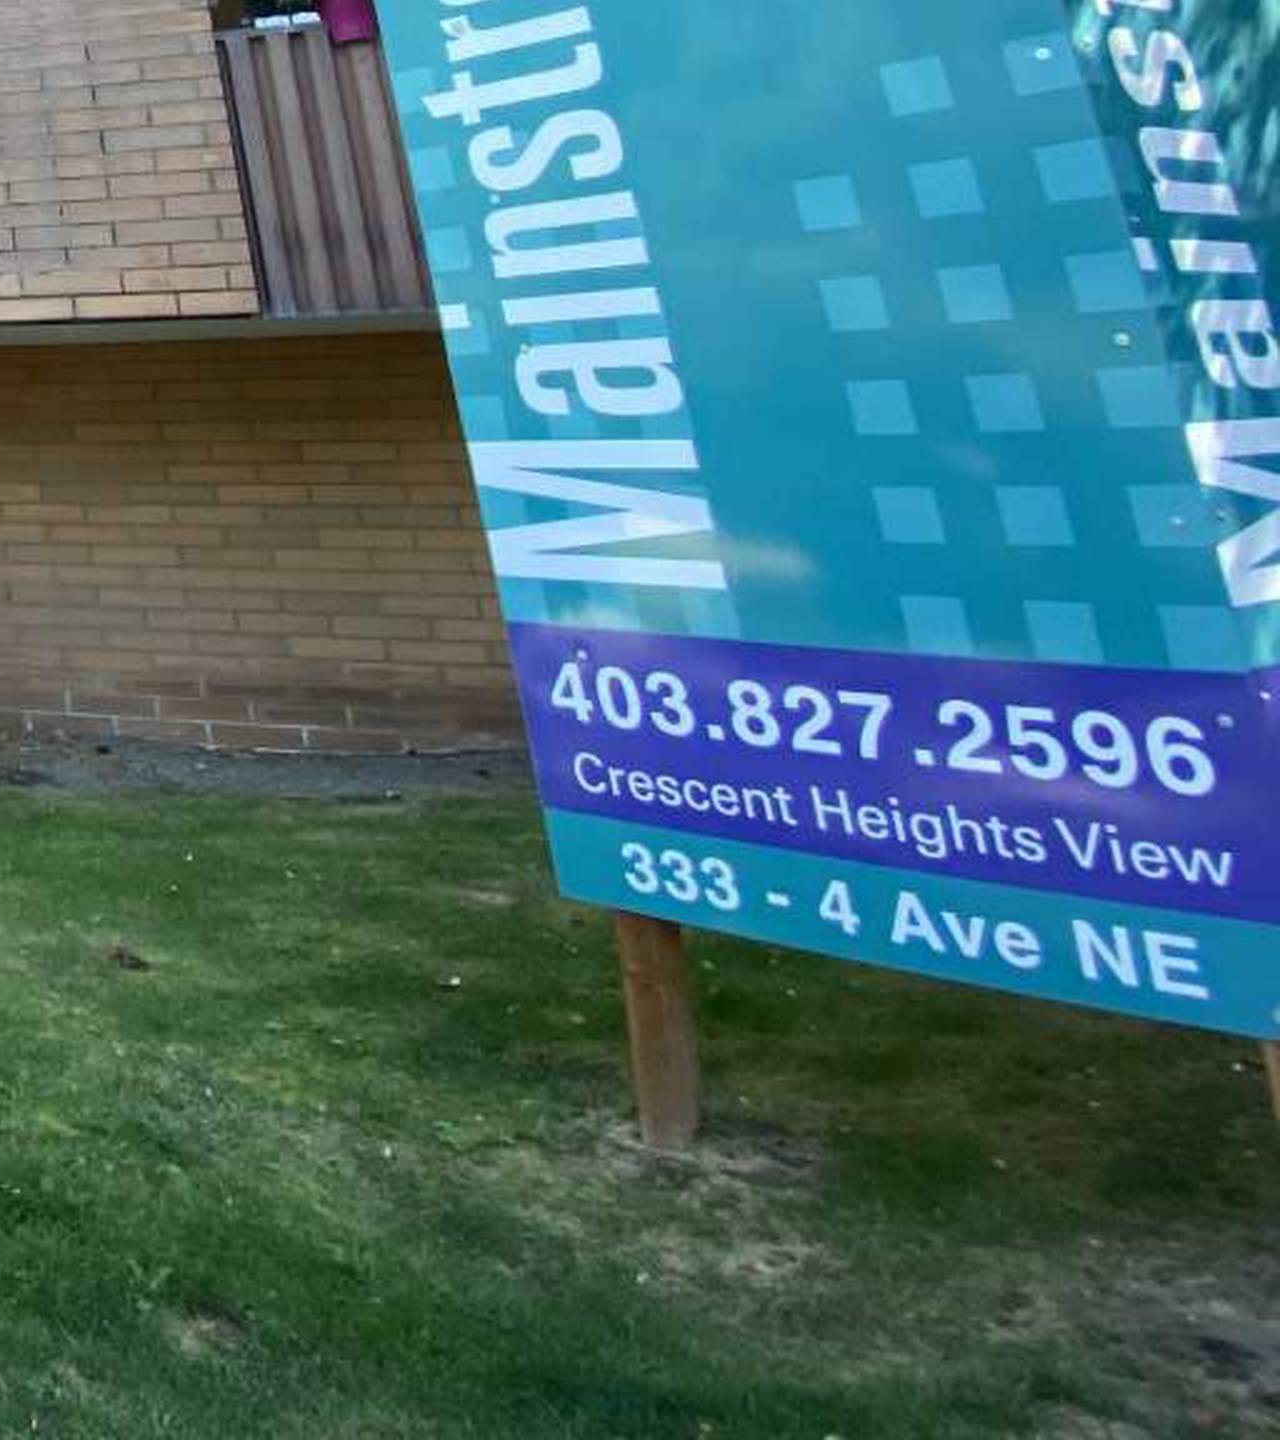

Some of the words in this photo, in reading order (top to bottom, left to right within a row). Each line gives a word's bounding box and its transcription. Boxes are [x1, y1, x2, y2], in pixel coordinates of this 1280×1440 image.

[550, 661, 1217, 797] 403.827.2596
[573, 752, 796, 827] Crescent
[811, 786, 1047, 863] Heights
[1055, 817, 1234, 888] View
[621, 841, 740, 912] 333
[818, 880, 860, 936] 4
[890, 890, 1042, 969] Ave
[1072, 918, 1212, 1000] NE
